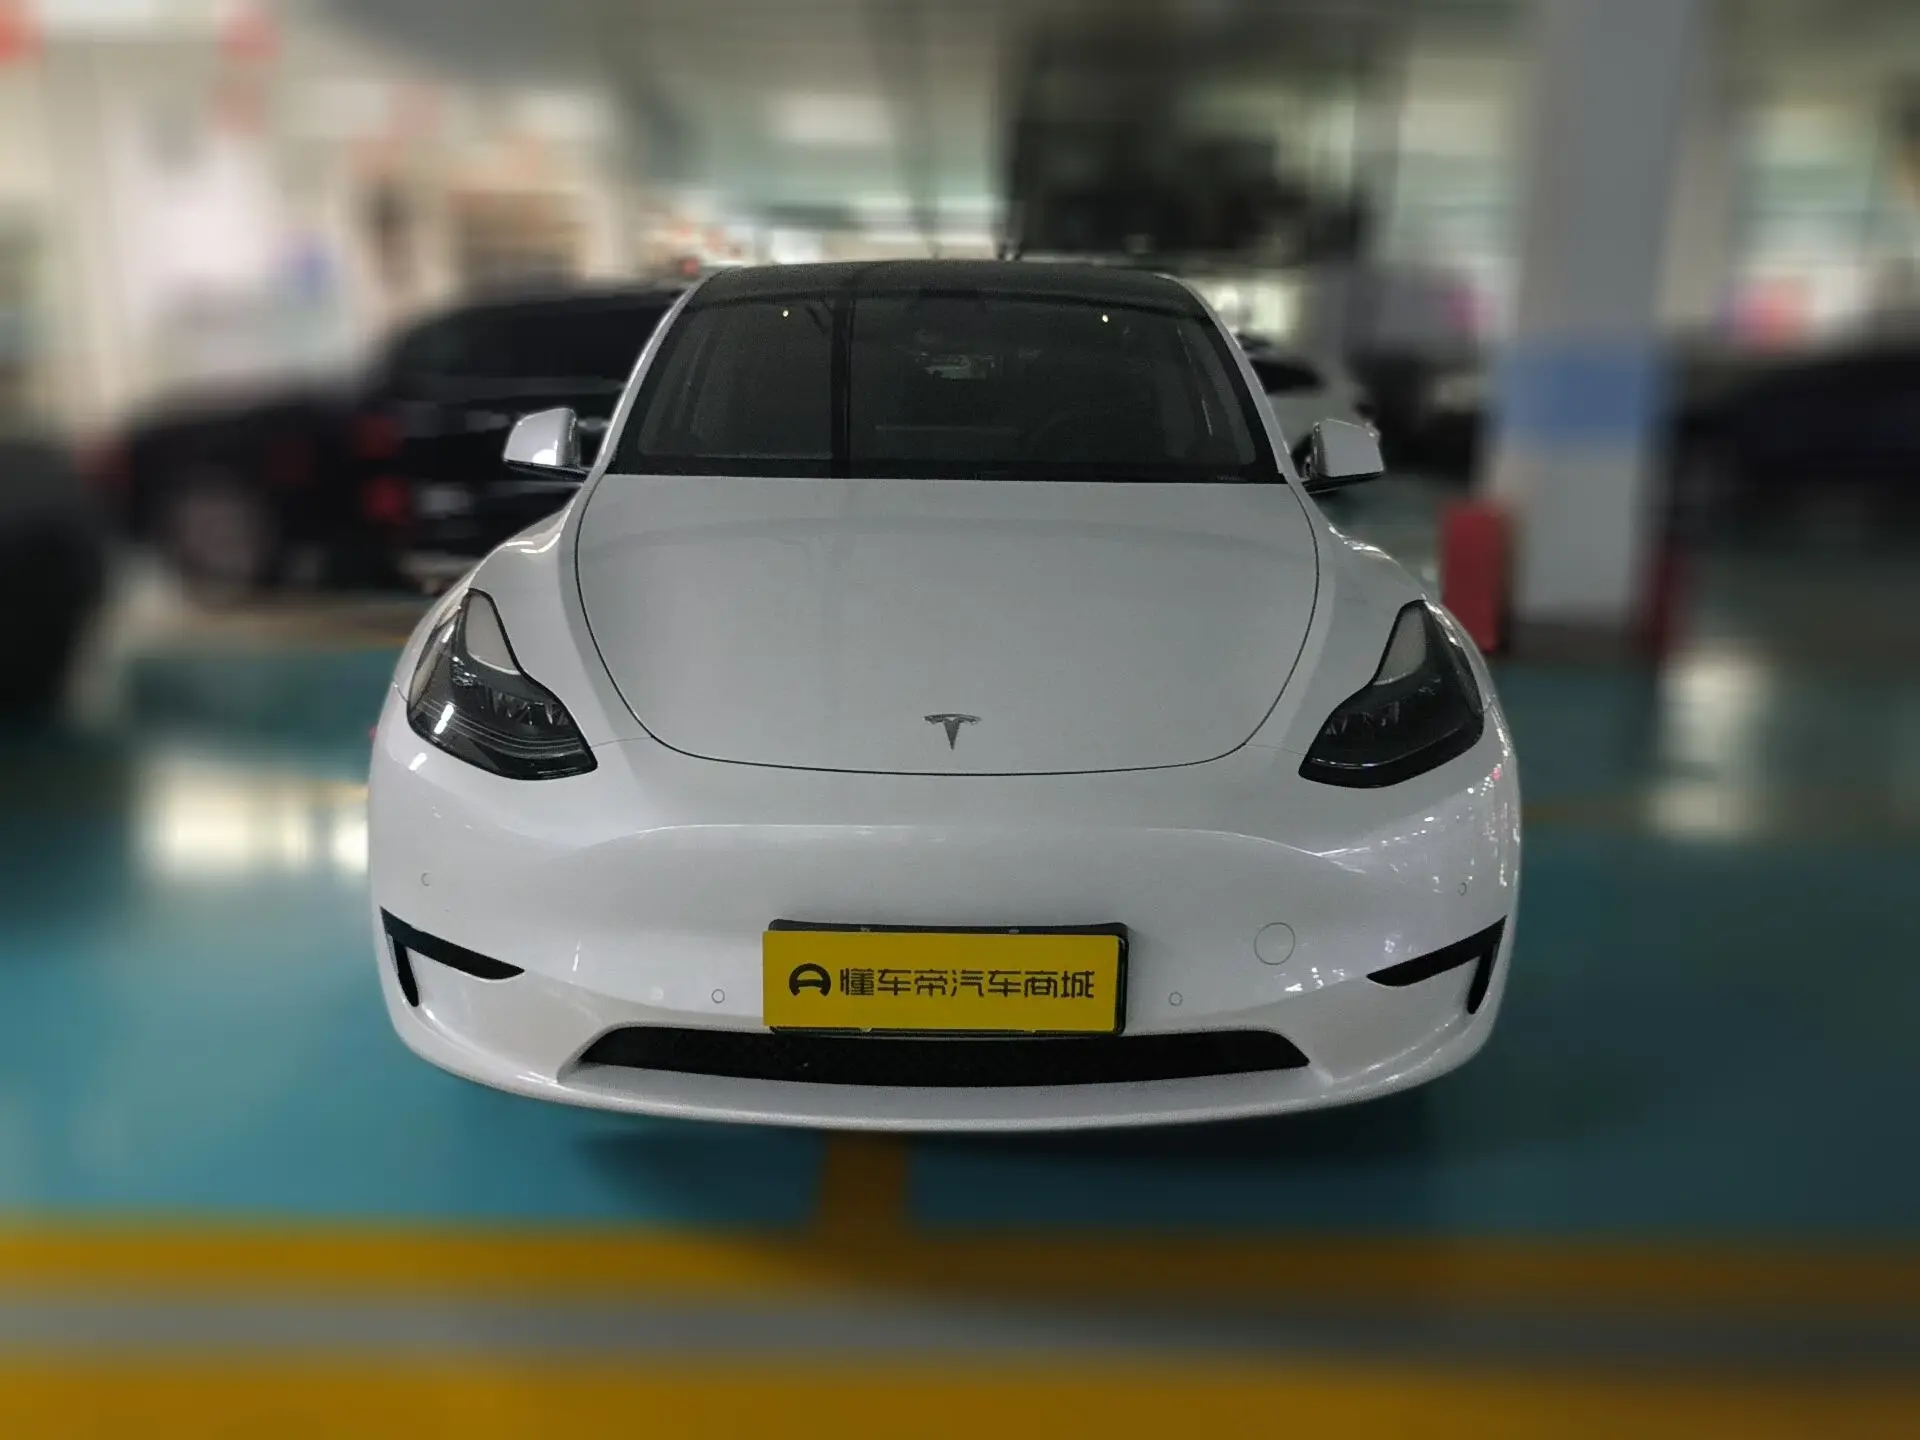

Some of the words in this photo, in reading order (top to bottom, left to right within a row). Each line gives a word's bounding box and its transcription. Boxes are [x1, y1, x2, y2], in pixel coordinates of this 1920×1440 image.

[840, 968, 1095, 998] 懂车帝汽车商城
